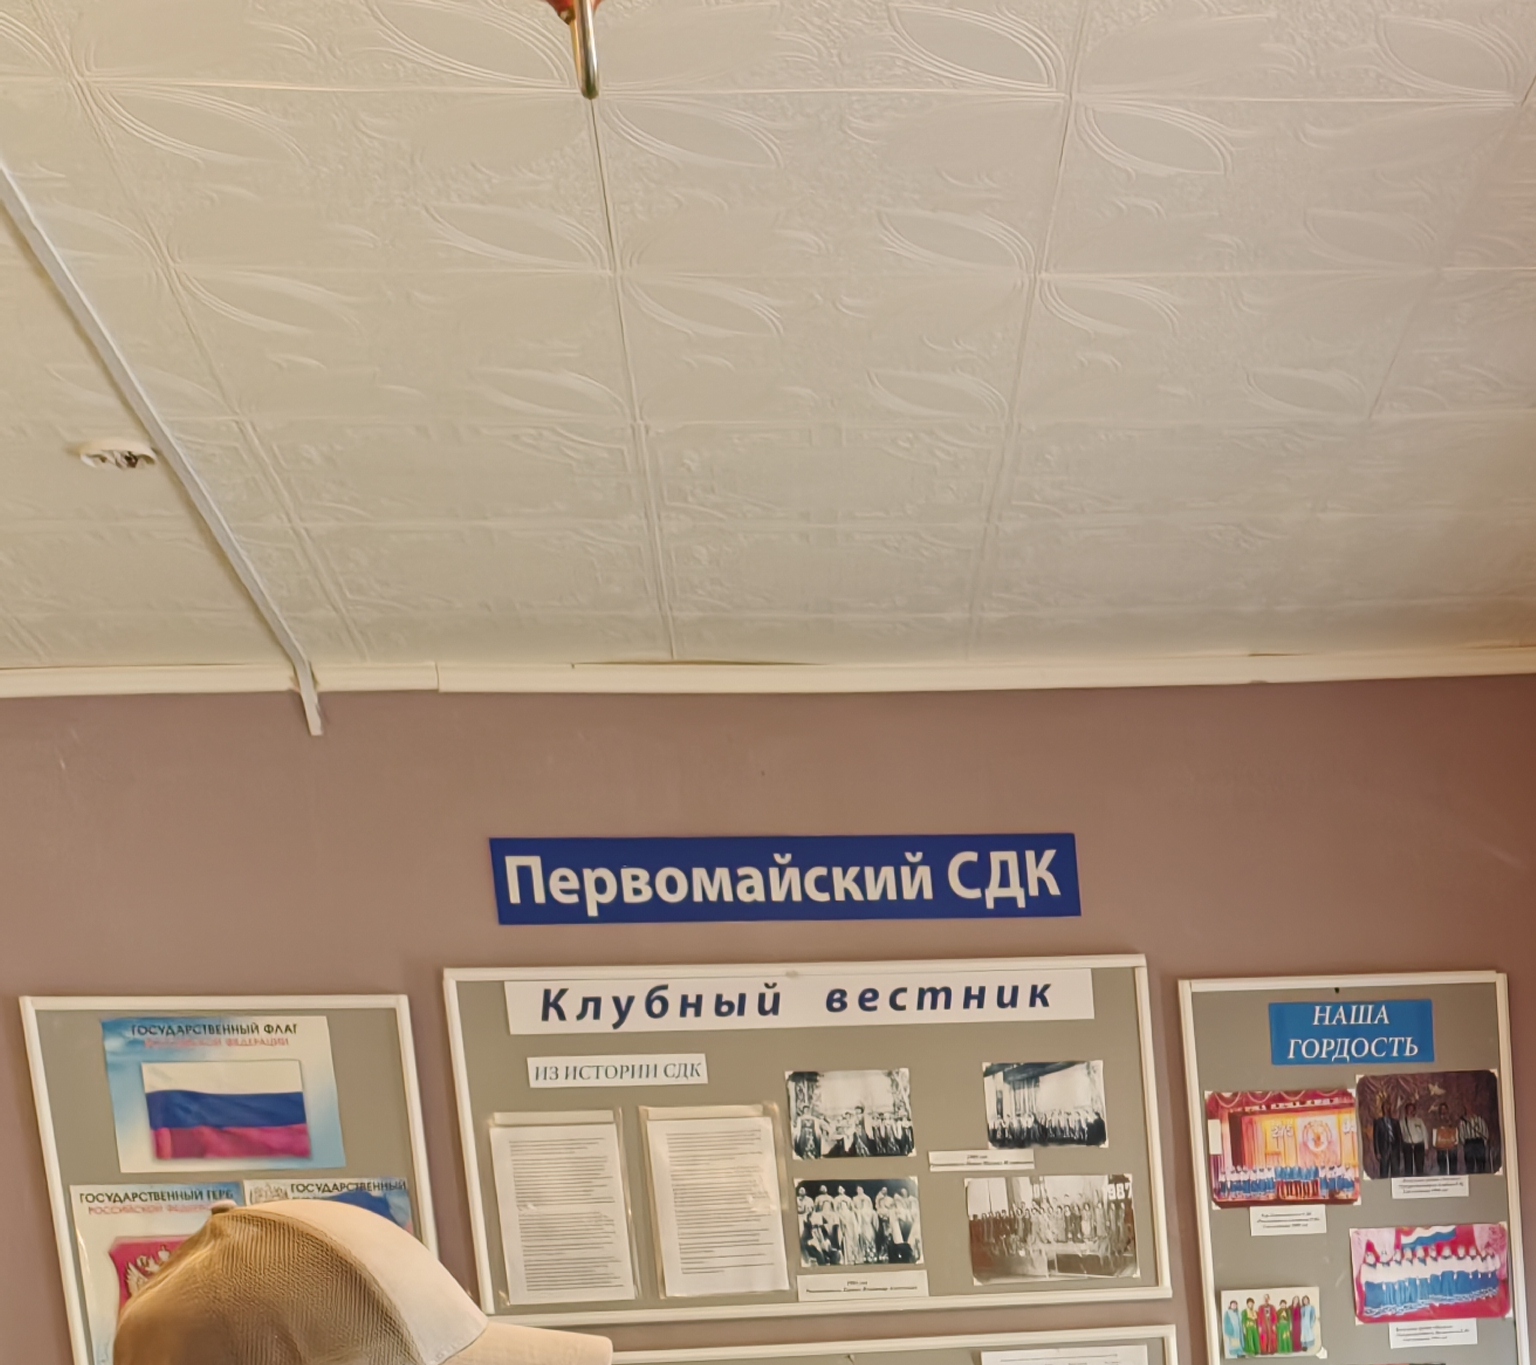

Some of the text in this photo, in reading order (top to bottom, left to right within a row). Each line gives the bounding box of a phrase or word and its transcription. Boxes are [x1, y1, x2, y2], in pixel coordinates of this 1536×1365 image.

[504, 849, 1062, 917] Первомайский СДК
[540, 982, 1052, 1030] Клубный вестник
[1313, 1004, 1390, 1026] НАША
[132, 1023, 299, 1037] ГОСУДАРСТВЕННЫЙ ФЛАГ
[1287, 1037, 1419, 1063] ГОРДОСТЬ
[534, 1062, 702, 1081] ИЗ ИСТОРИИ СДК
[79, 1189, 233, 1203] ГОСУДАРСТВЕННЫЙ ГЕРБ
[291, 1179, 407, 1193] ГОСУДАРСТВЕННЫЙ
